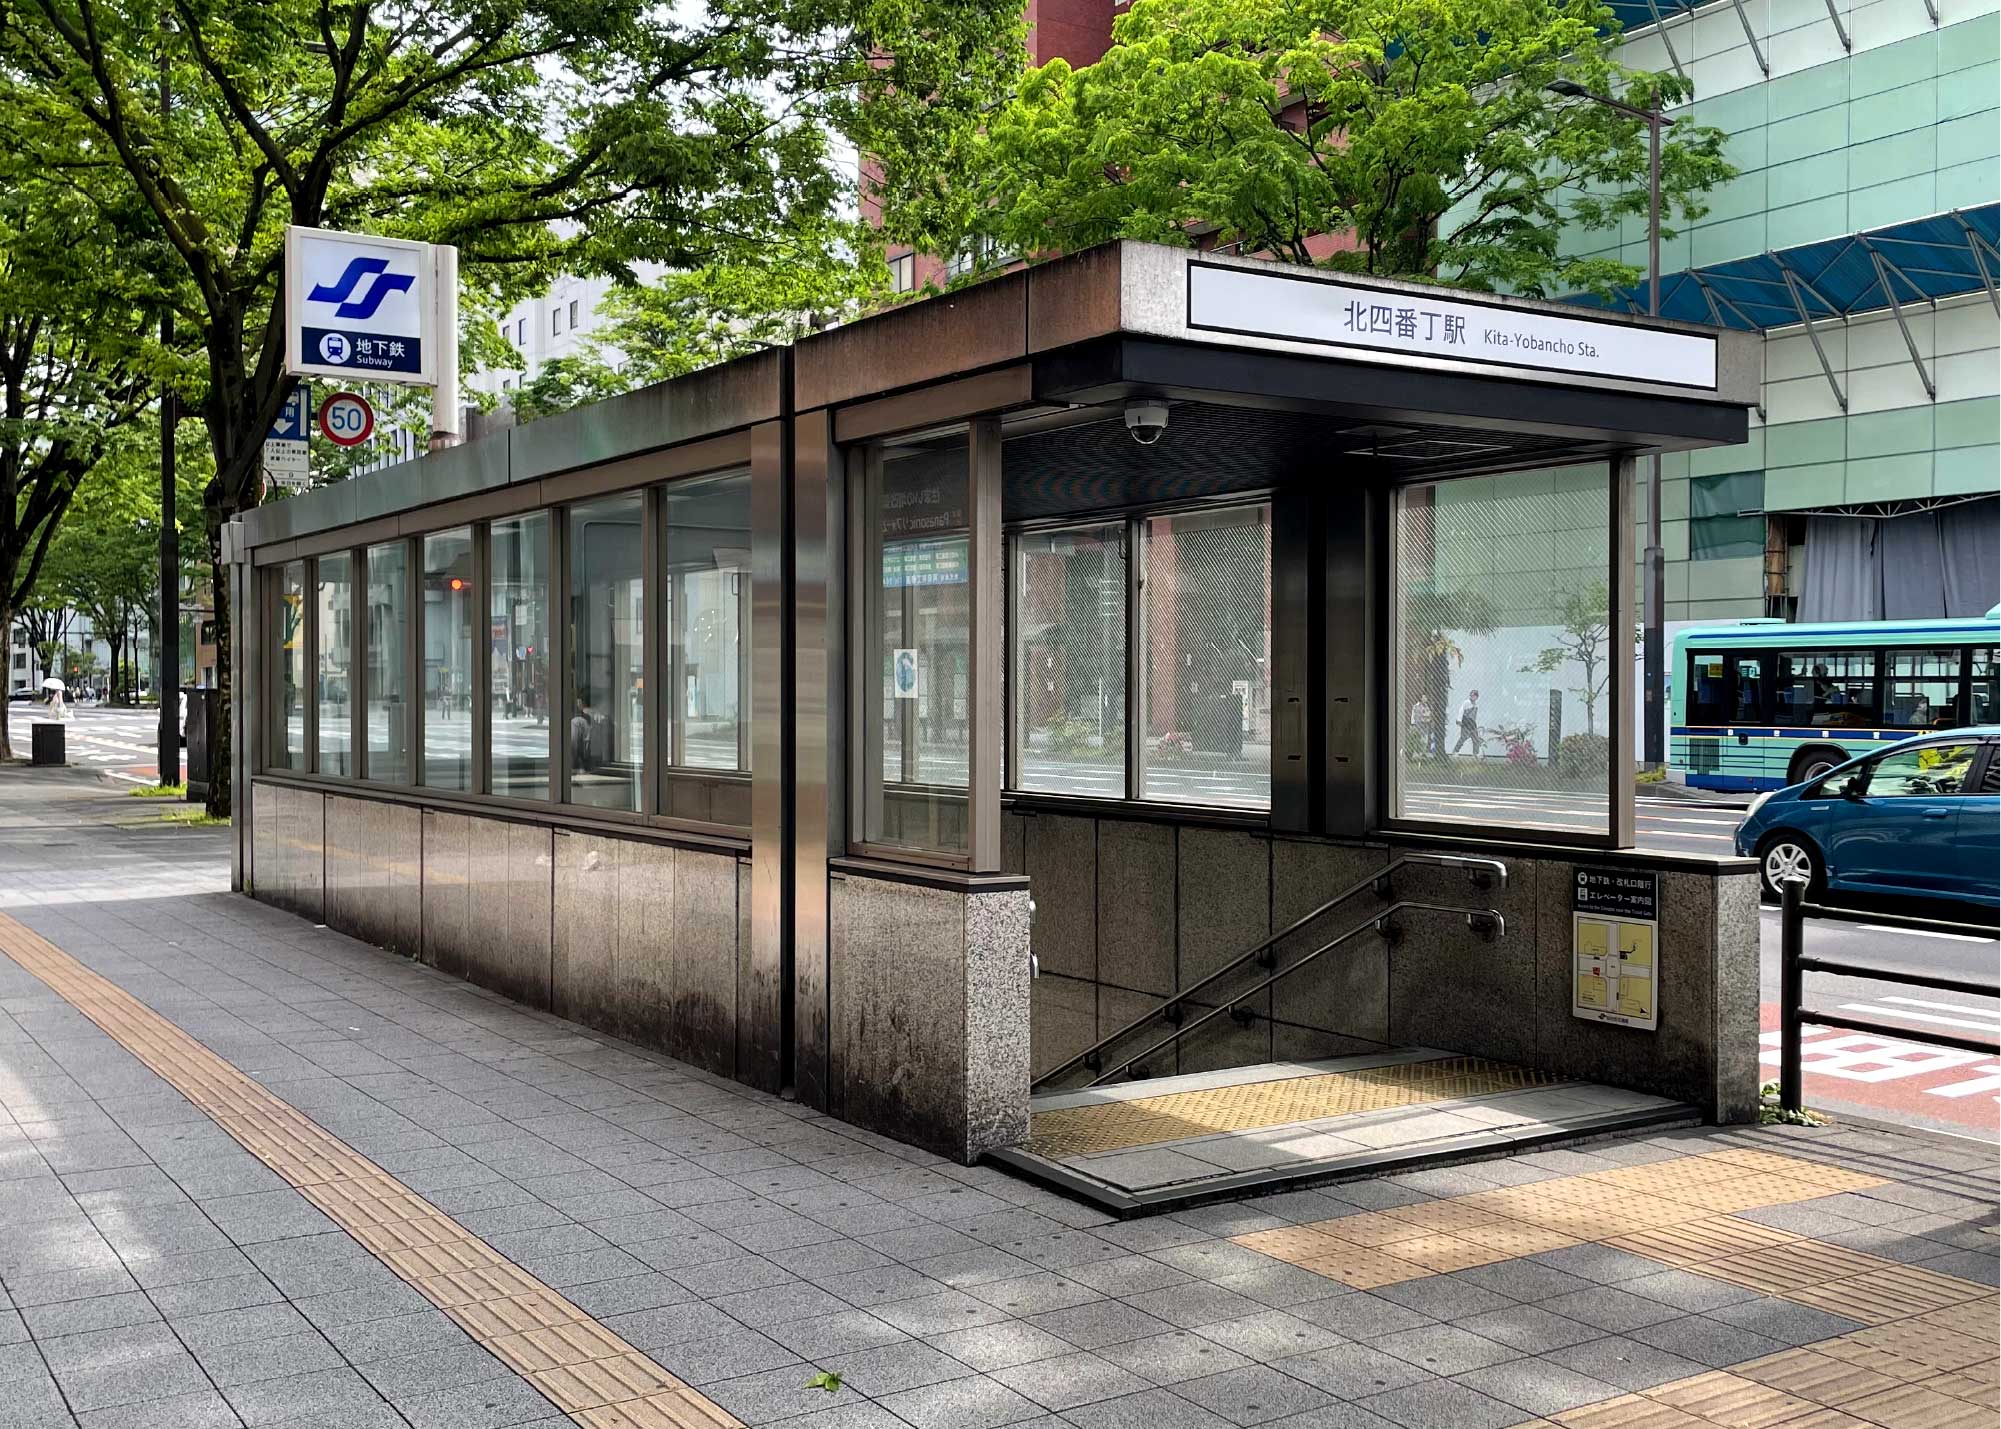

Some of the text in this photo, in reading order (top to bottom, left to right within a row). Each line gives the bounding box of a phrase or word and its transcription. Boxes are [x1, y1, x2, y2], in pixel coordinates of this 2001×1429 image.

[1344, 300, 1466, 344] 北四番丁駅
[356, 338, 405, 358] 地下鉄
[1484, 328, 1600, 358] Kita-Yobancho Sta.
[356, 354, 393, 368] Subway
[332, 406, 362, 431] 50
[1589, 891, 1653, 906] エレベーター案内図
